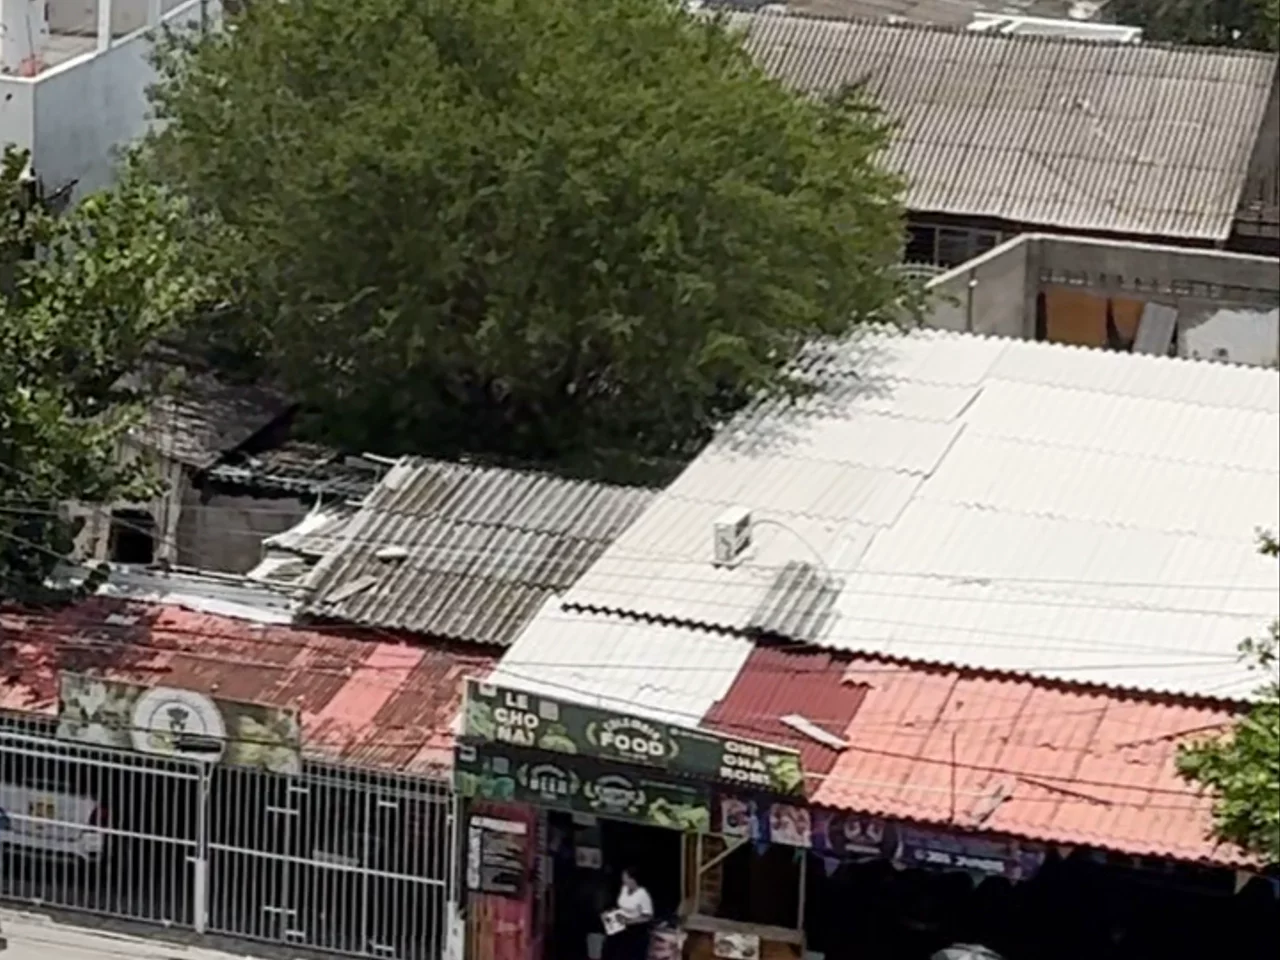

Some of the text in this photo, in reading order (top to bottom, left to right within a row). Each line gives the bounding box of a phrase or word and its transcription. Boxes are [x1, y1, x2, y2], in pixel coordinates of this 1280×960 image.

[506, 691, 529, 709] LE
[494, 707, 539, 729] CHO
[600, 732, 665, 756] FOOD
